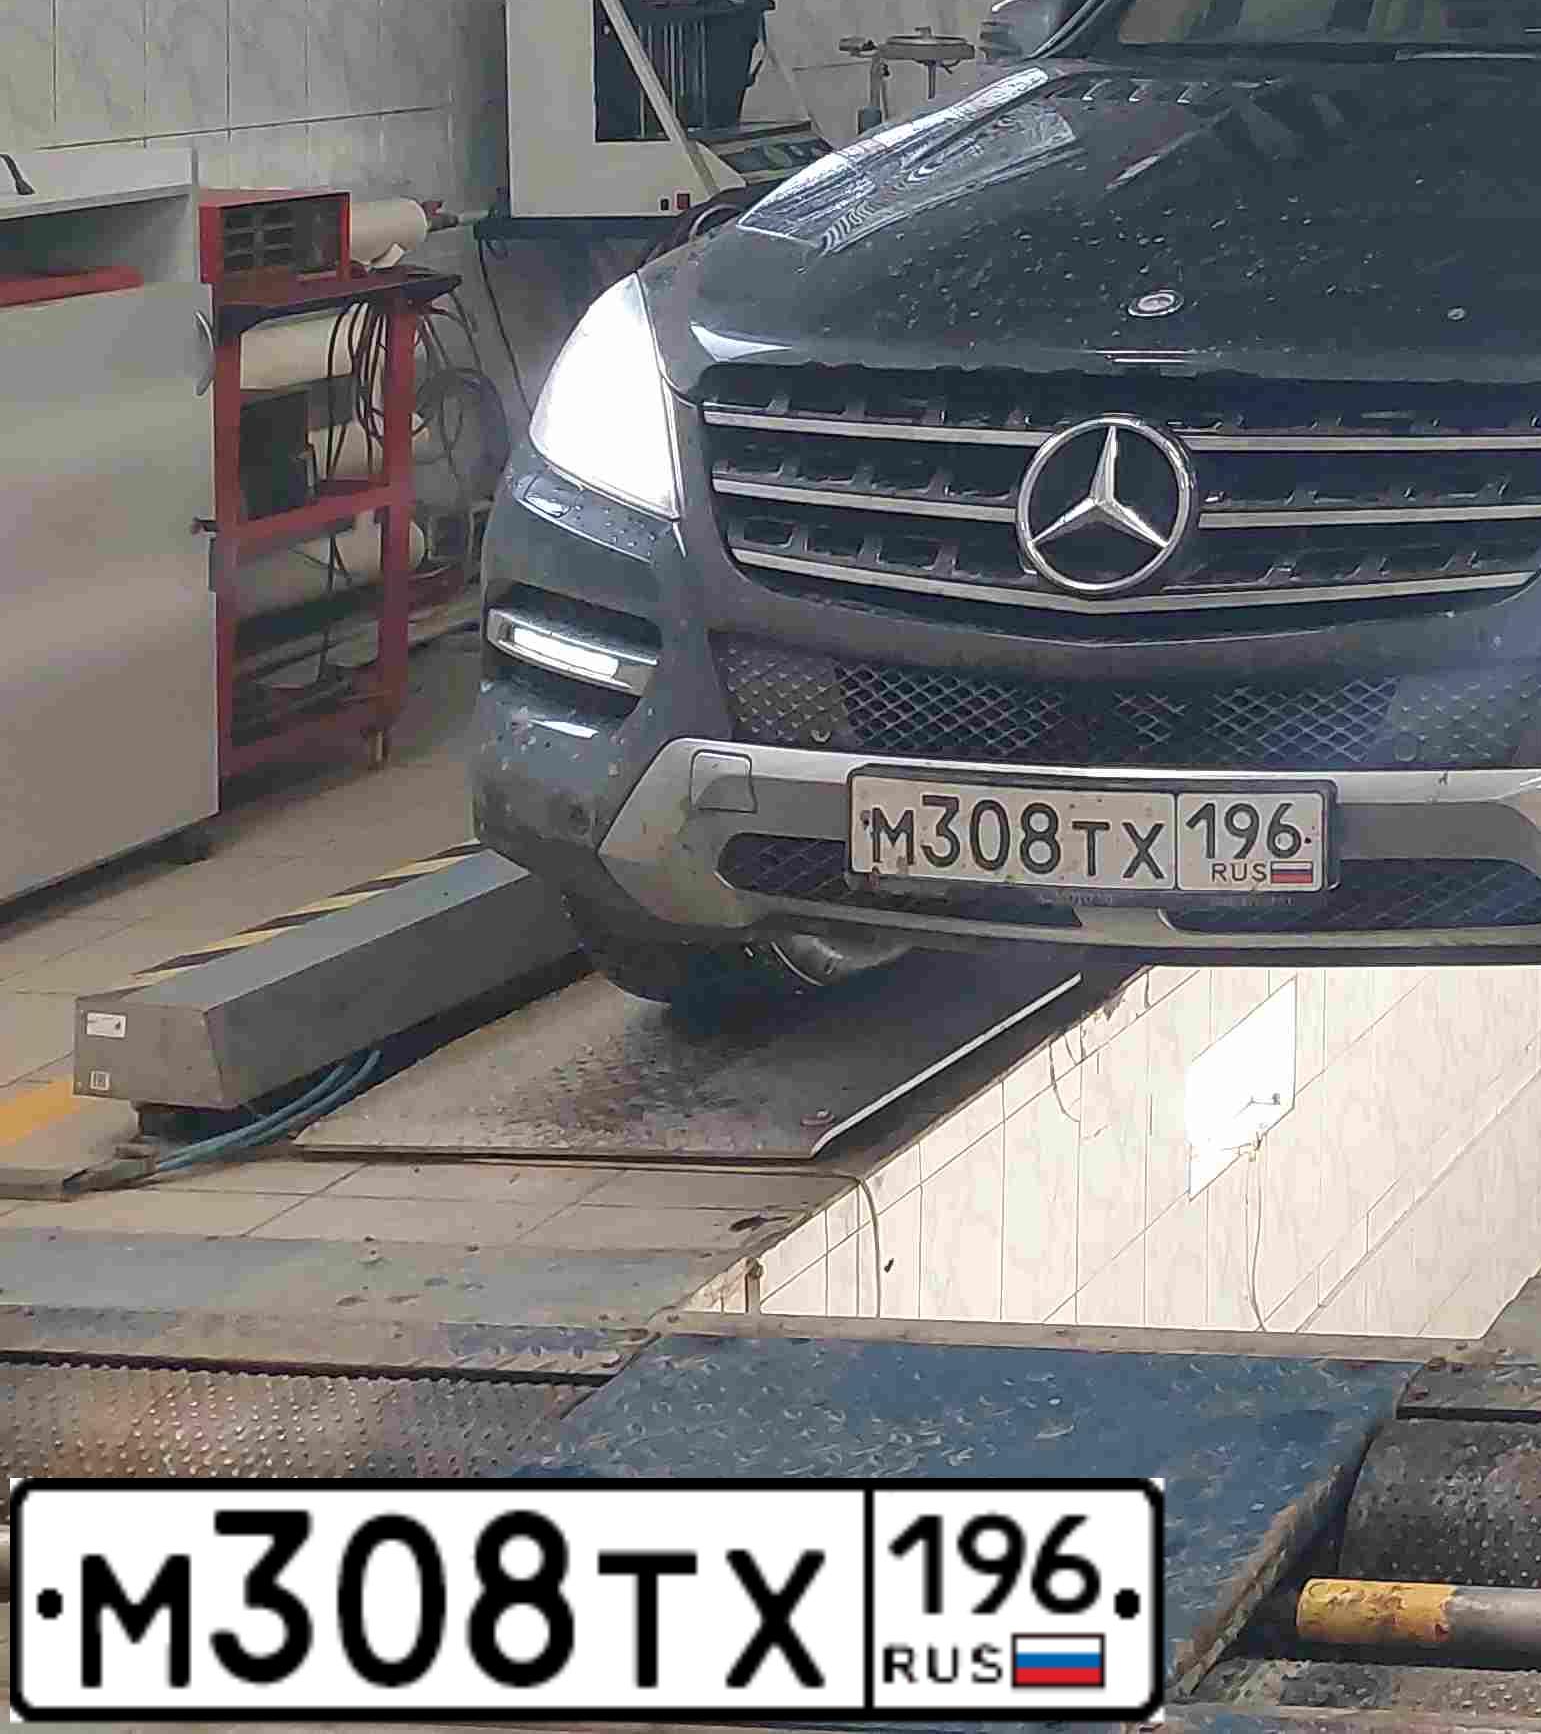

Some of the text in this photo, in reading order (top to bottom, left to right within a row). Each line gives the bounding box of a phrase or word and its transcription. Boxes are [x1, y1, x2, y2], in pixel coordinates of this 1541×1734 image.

[871, 794, 1302, 879] М308ТХ 196
[1211, 863, 1267, 882] RUS
